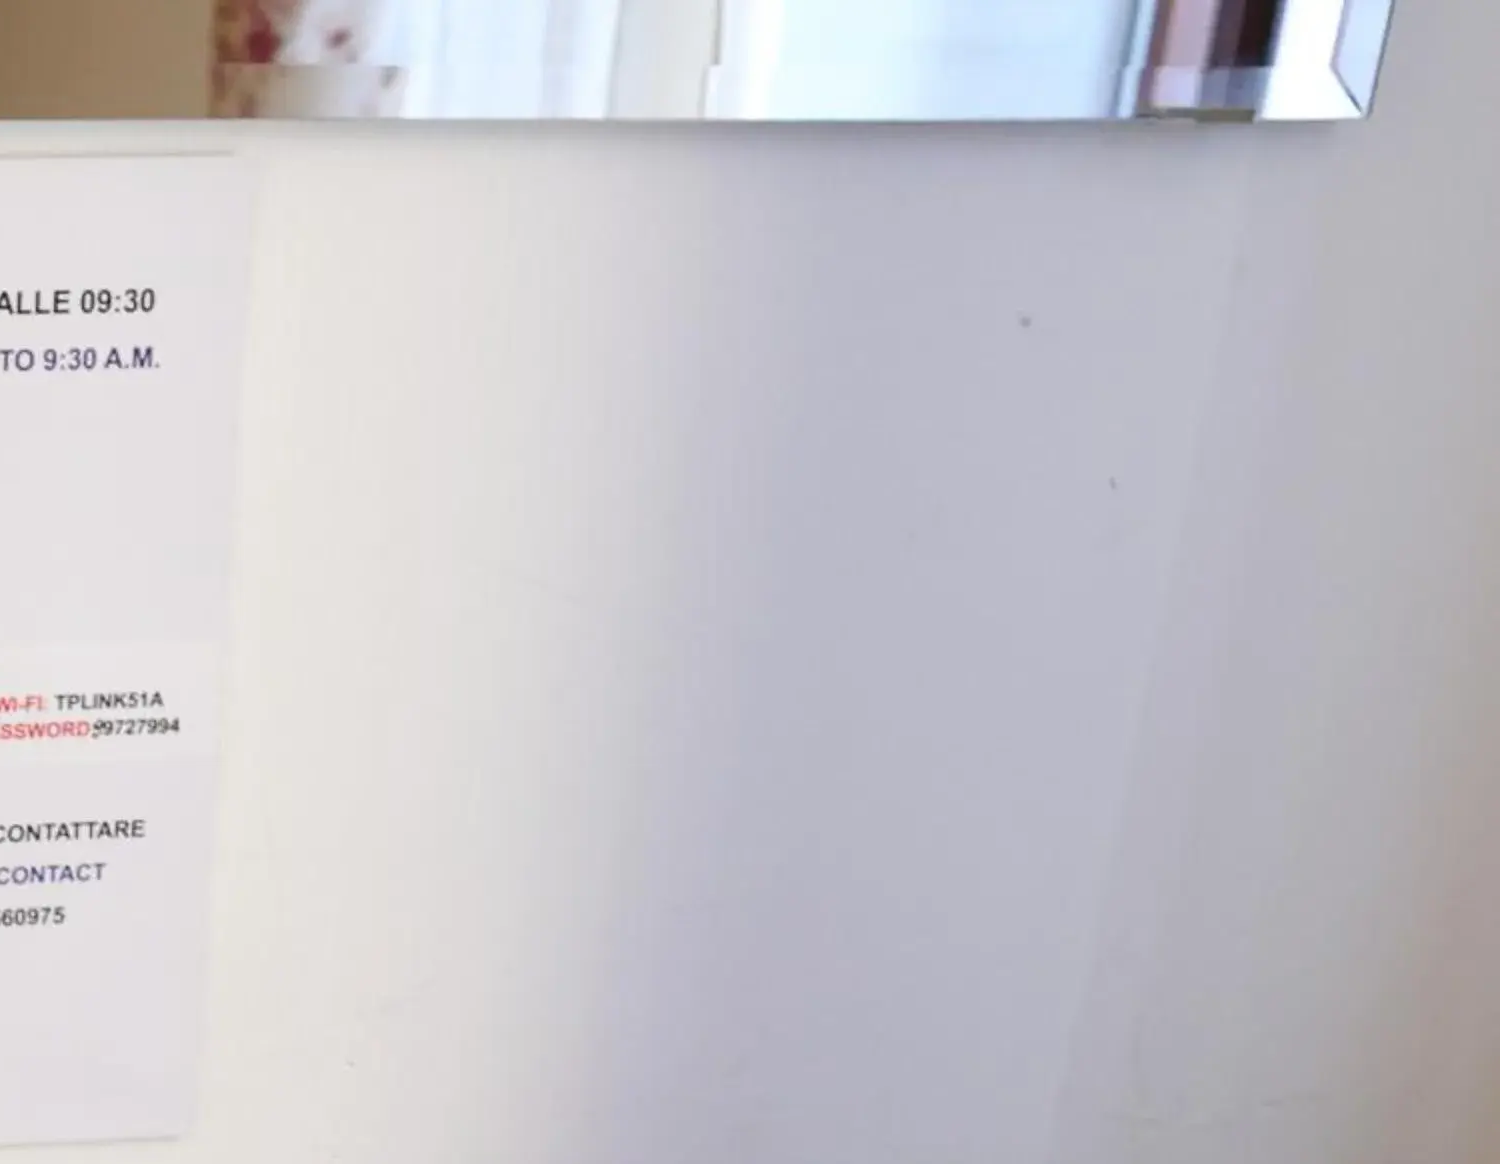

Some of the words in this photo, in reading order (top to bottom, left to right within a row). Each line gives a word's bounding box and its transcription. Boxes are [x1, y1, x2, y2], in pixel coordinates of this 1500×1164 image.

[79, 288, 156, 313] 09:30
[43, 347, 97, 370] 9:30
[104, 346, 160, 369] A.M.
[54, 691, 165, 711] TPLINK51A
